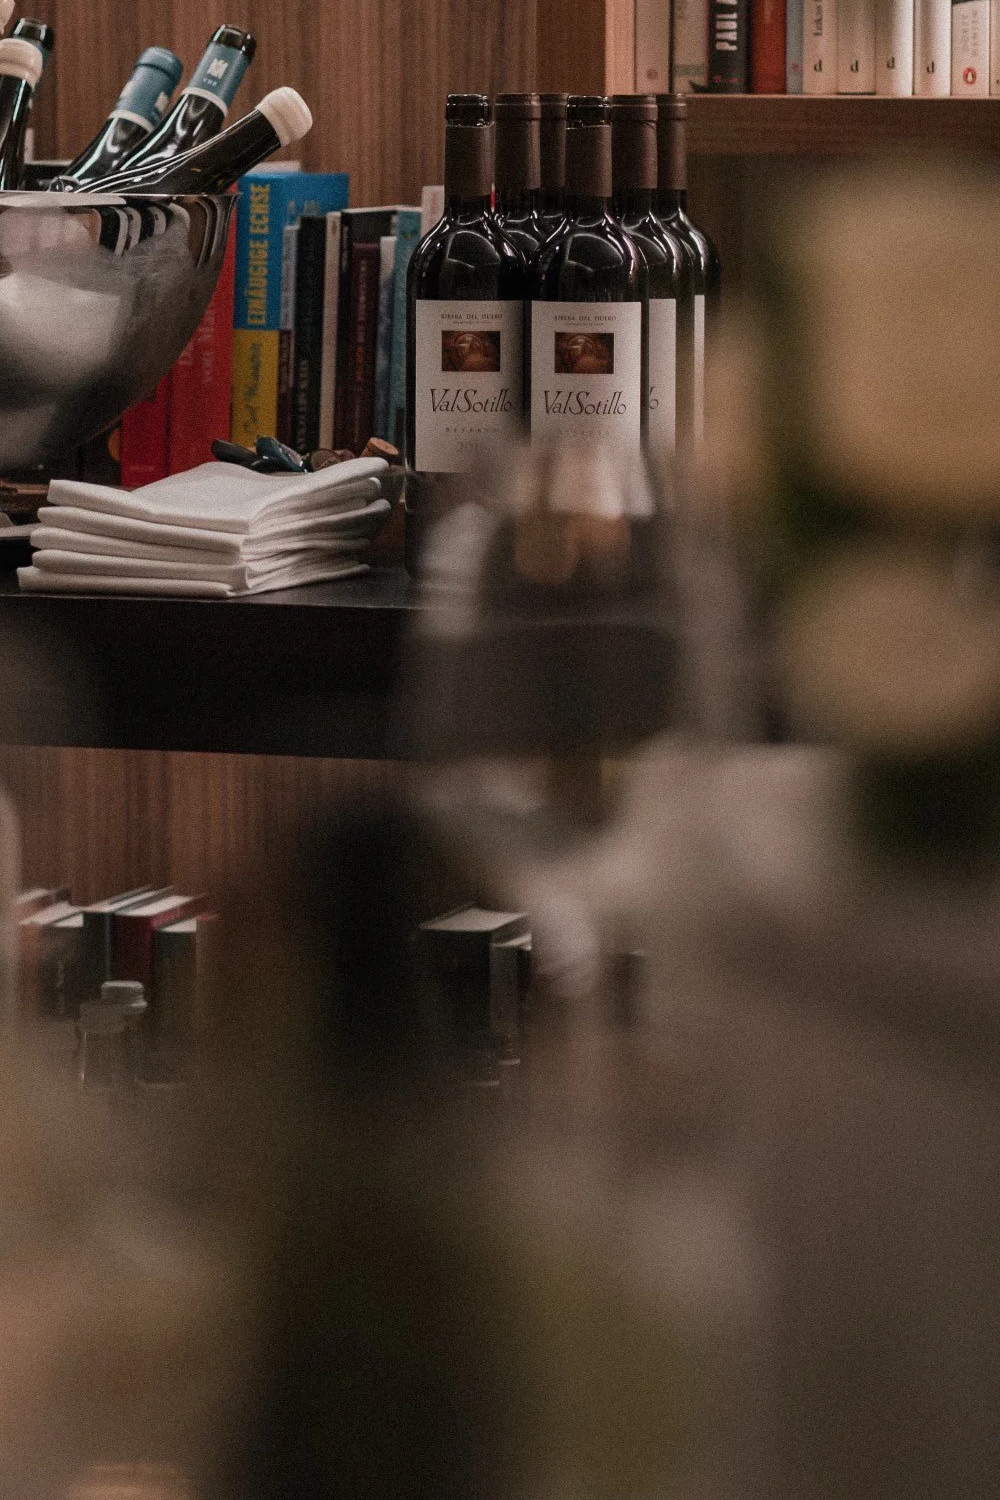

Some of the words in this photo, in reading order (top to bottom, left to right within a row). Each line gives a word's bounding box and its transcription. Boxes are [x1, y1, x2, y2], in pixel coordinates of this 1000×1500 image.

[715, 13, 738, 52] PAUL
[244, 183, 269, 234] ECHSE
[430, 388, 514, 413] ValSotillo
[543, 390, 625, 414] ValSotillo
